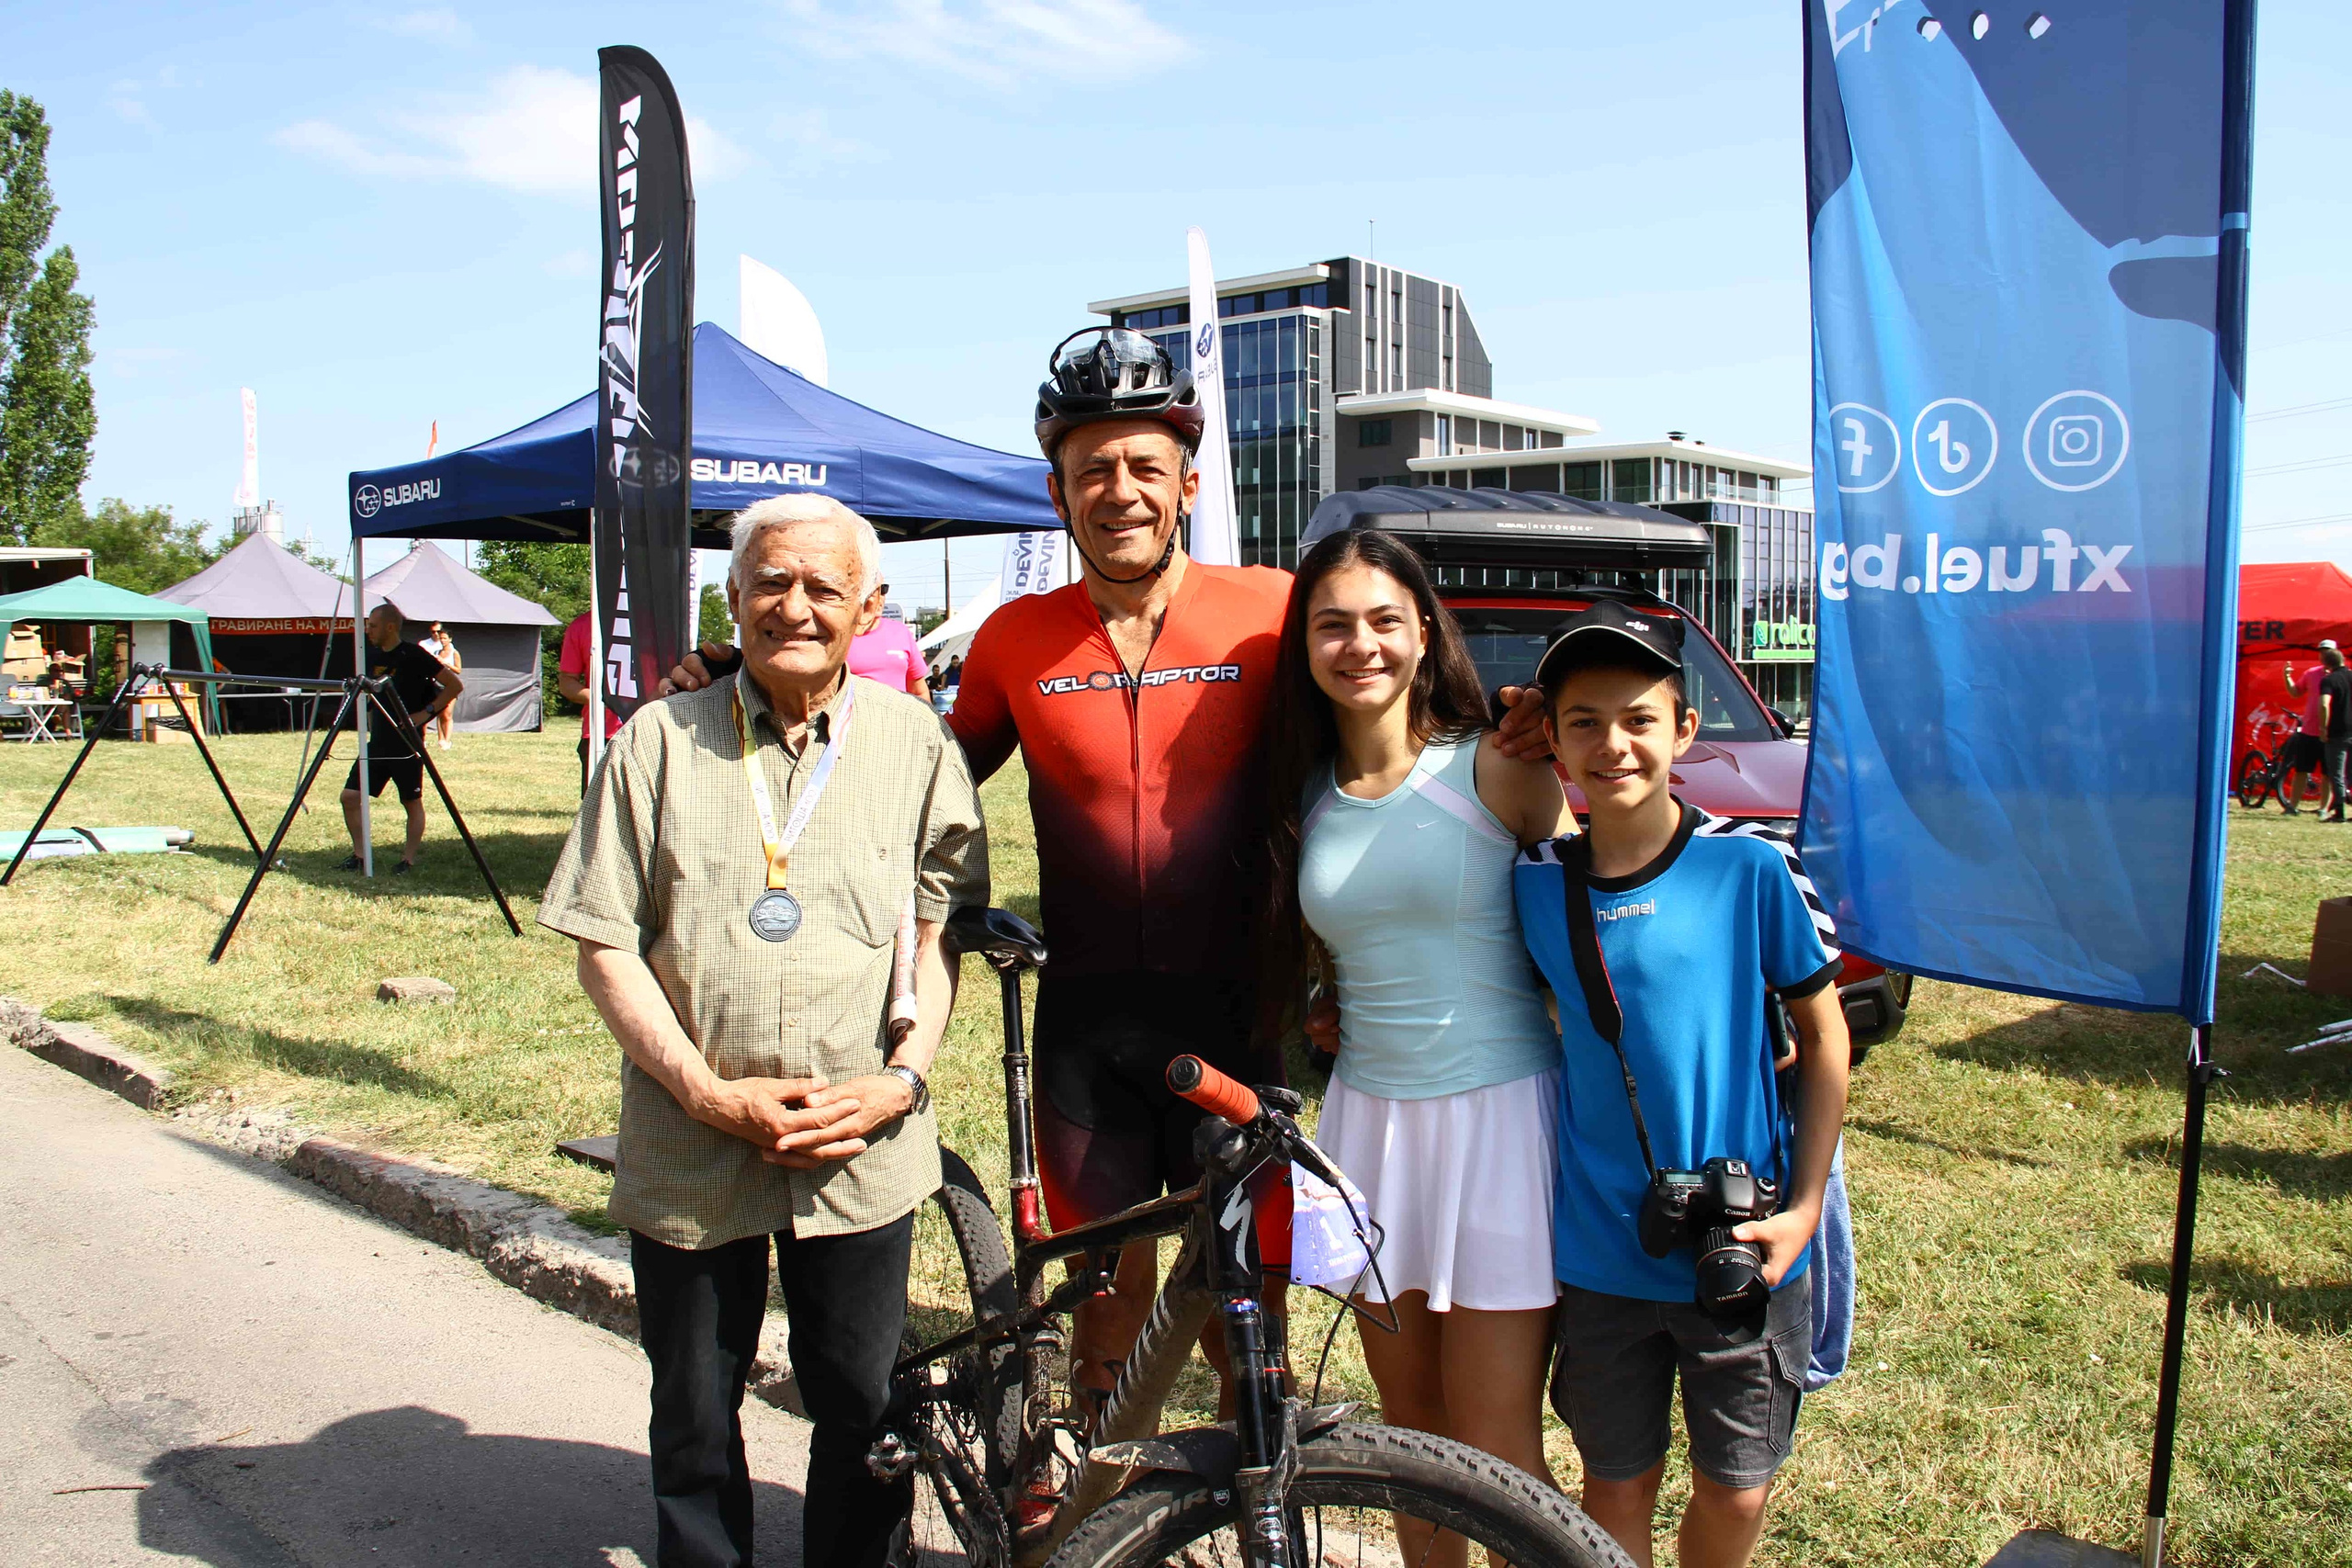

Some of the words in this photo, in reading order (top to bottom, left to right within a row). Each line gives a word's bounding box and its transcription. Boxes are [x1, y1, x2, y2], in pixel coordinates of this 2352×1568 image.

[690, 458, 827, 487] SUBARU
[383, 478, 441, 507] SUBARU
[210, 619, 293, 631] ГРАВИРАНЕ
[296, 619, 316, 630] НА
[1596, 898, 1656, 923] hummel
[1016, 1066, 1026, 1098] DIVINE
[1724, 1208, 1751, 1217] Canon
[1319, 1215, 1344, 1250] 1
[1715, 1291, 1749, 1303] TAMRON
